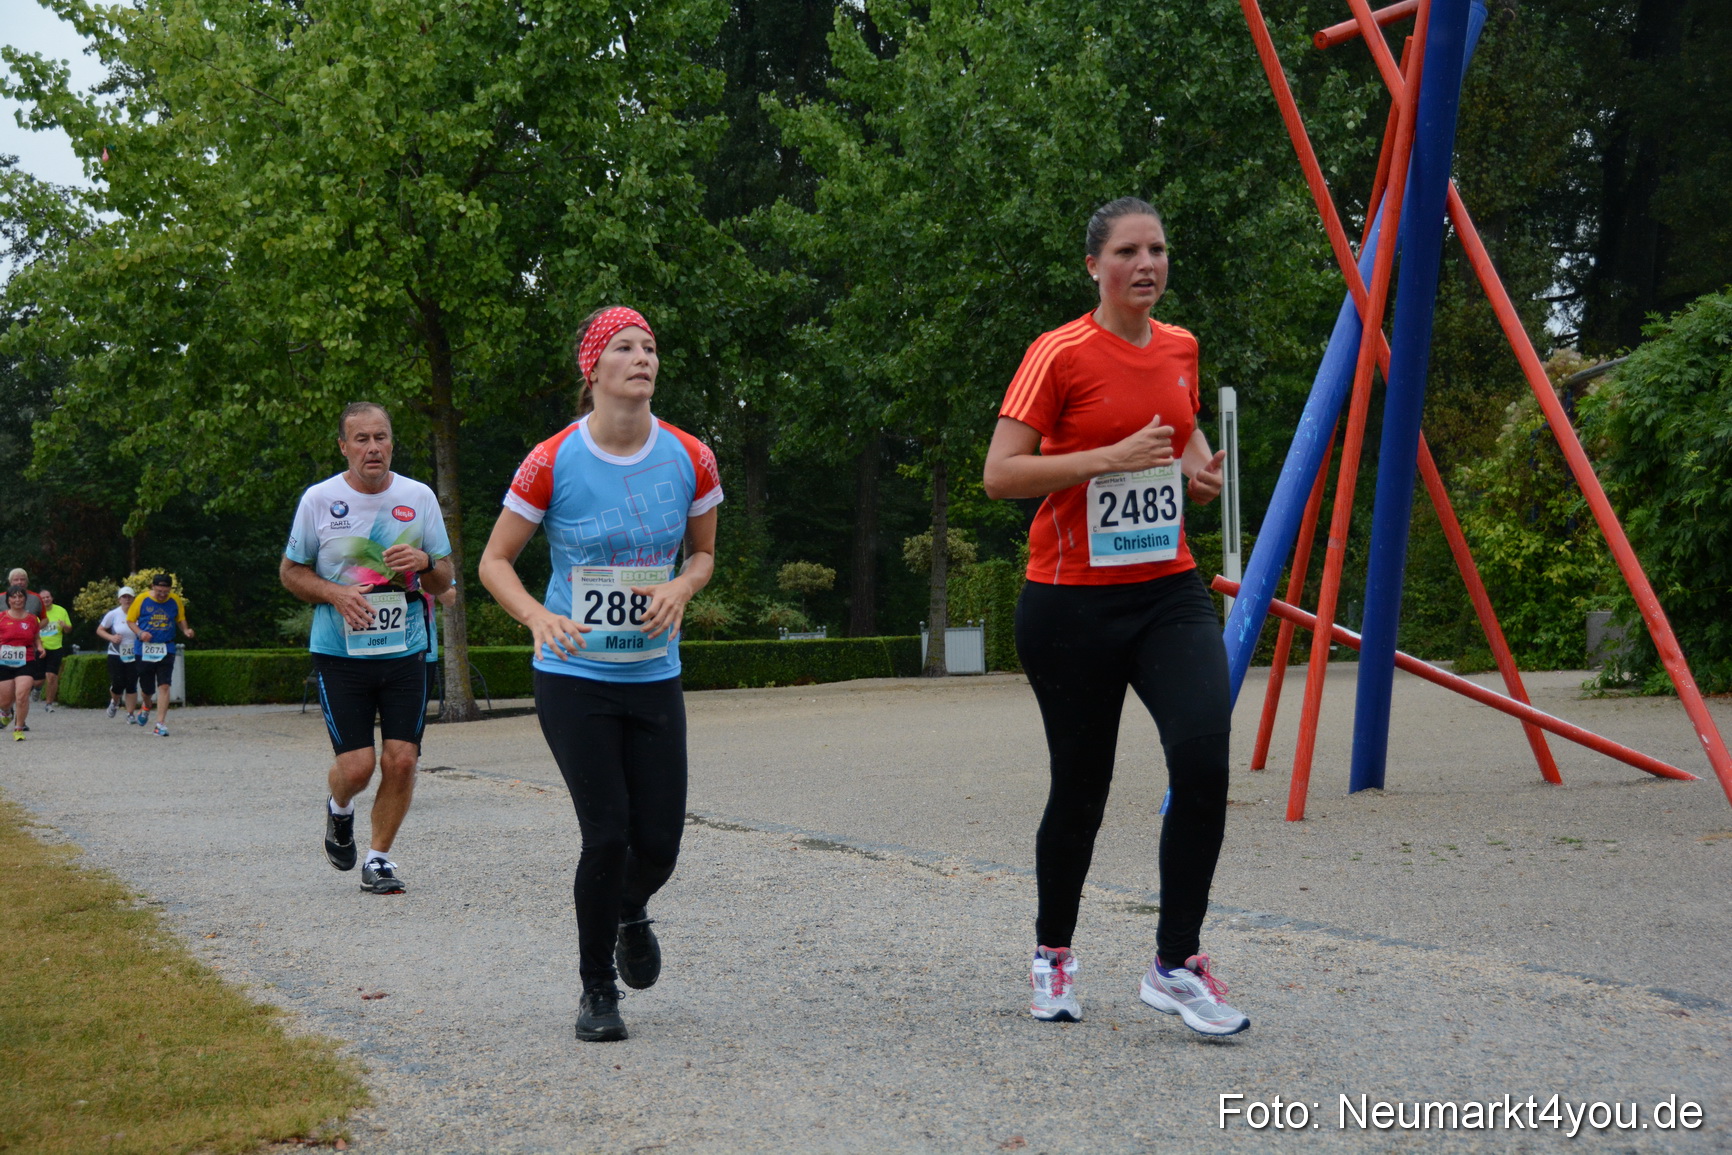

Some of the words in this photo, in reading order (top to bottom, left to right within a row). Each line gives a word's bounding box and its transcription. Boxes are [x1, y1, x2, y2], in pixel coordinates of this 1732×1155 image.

[1099, 485, 1177, 528] 2483
[1114, 533, 1170, 551] Christina
[621, 569, 667, 581] BOCK
[584, 590, 655, 626] 288
[368, 636, 387, 647] Josef
[606, 635, 644, 649] Maria
[2, 650, 24, 659] 2516
